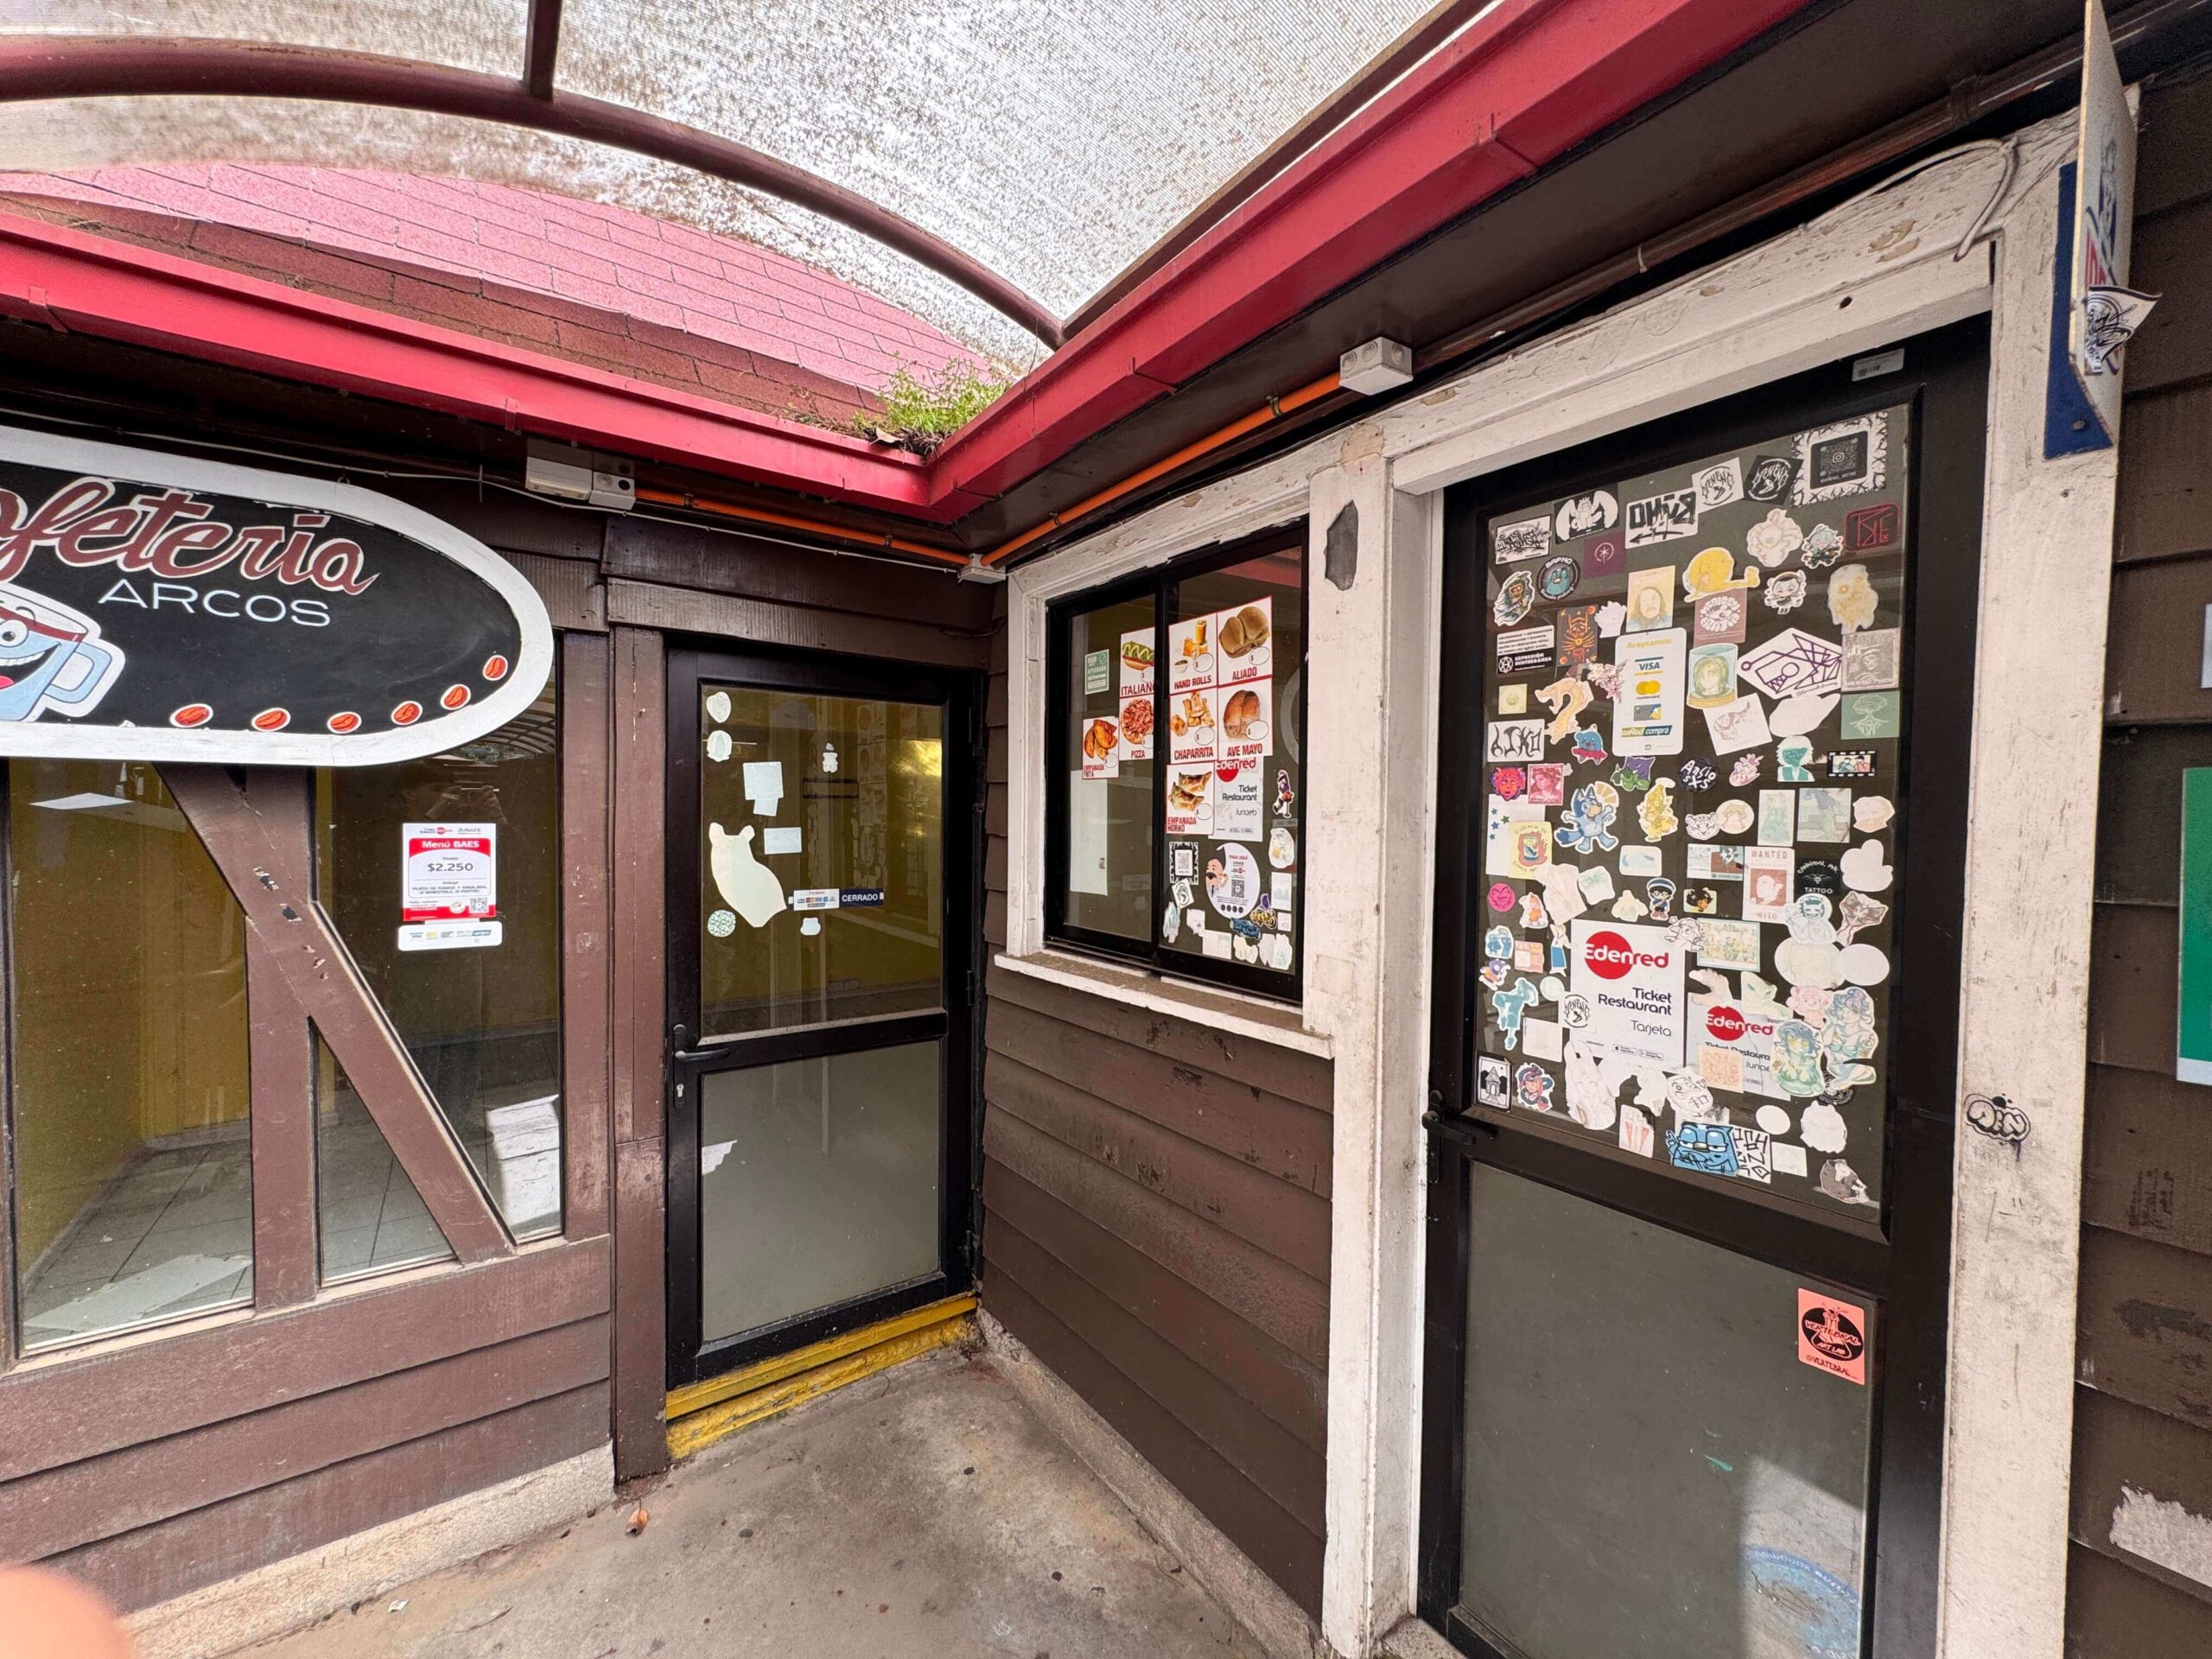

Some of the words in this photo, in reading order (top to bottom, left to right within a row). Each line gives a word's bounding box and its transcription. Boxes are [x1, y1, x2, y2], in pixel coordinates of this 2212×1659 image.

[98, 579, 331, 626] ARCOS
[1638, 662, 1660, 671] VISA
[1232, 667, 1257, 681] ALIADO
[1174, 679, 1191, 690] HAND
[1192, 675, 1211, 686] ROLLS
[1131, 750, 1146, 759] PIZZA
[1174, 747, 1213, 760] CHAPARRITA
[1227, 746, 1240, 757] AVE
[1243, 743, 1262, 755] MAYO
[422, 840, 450, 849] Menú
[1751, 850, 1788, 859] WANTED
[427, 862, 474, 872] $2.250
[842, 893, 879, 902] CERRADO
[1585, 943, 1669, 969] Edenred
[1632, 987, 1672, 1003] Ticket
[1598, 993, 1672, 1016] Restaurant
[1630, 1020, 1672, 1037] Tarjeta
[1706, 1014, 1773, 1035] Edenred
[1806, 1320, 1859, 1344] VERTEBRAL
